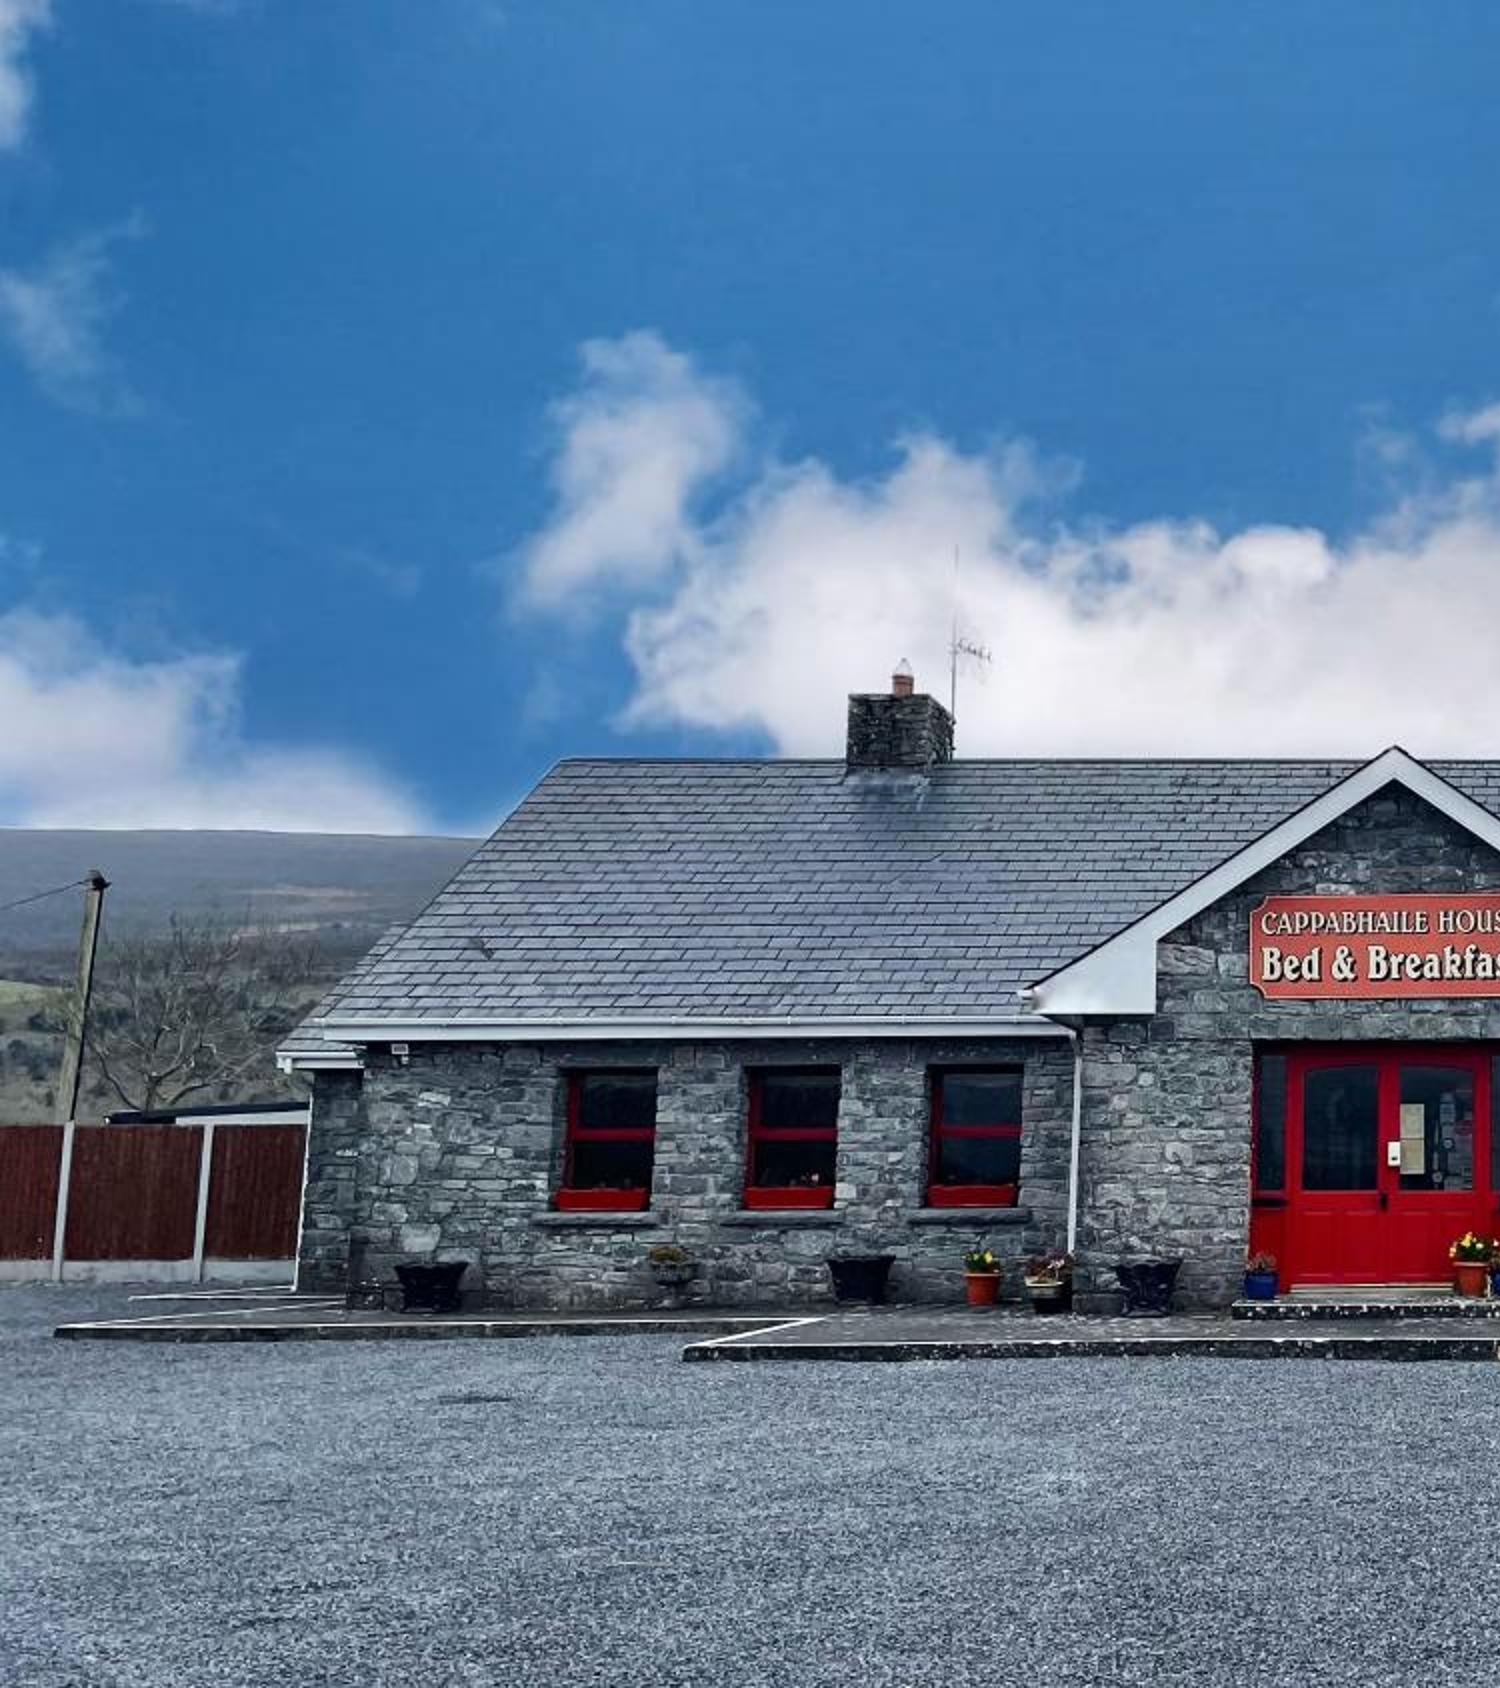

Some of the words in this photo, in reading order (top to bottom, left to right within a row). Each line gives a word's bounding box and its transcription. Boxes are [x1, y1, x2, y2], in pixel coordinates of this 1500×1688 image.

[1261, 910, 1429, 935] CAPPABHAILE
[1261, 946, 1322, 981] Bed
[1331, 945, 1355, 981] &
